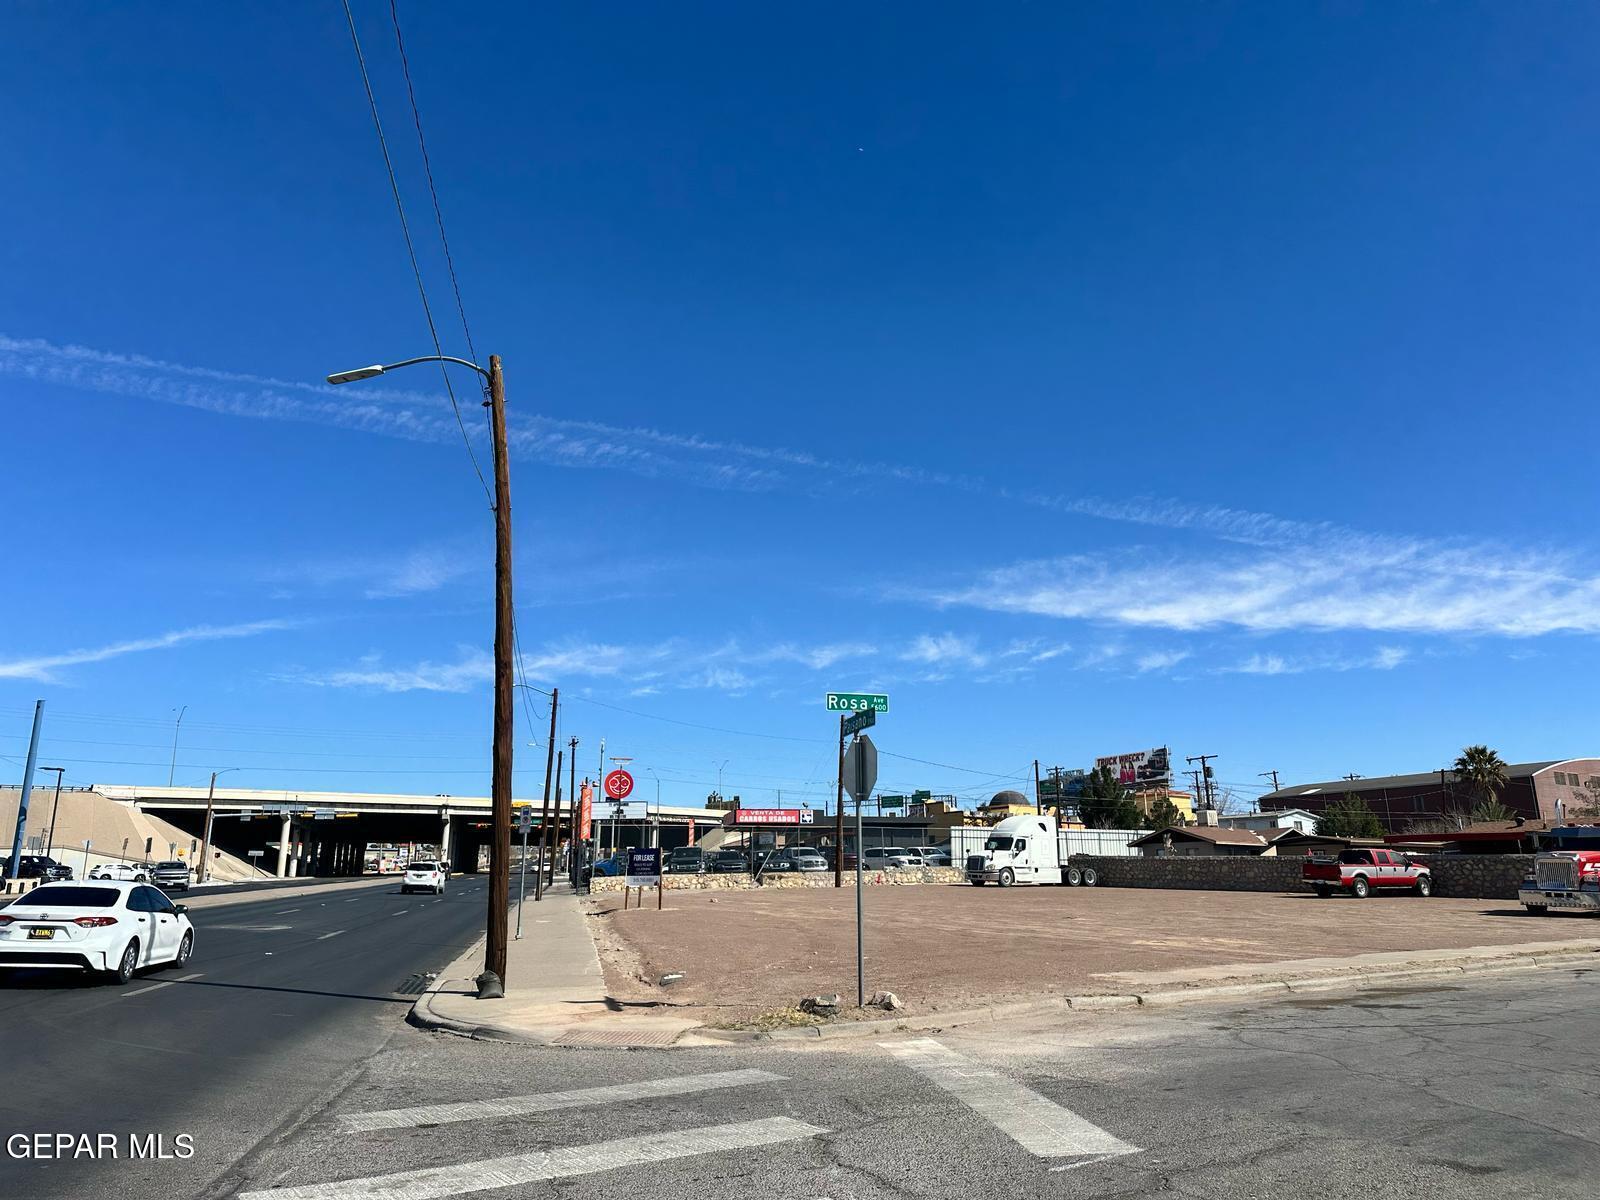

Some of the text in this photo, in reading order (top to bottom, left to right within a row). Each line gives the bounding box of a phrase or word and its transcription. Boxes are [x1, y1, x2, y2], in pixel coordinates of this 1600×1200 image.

[828, 695, 868, 710] Rosa
[1096, 752, 1146, 767] TRUCK WRECK?
